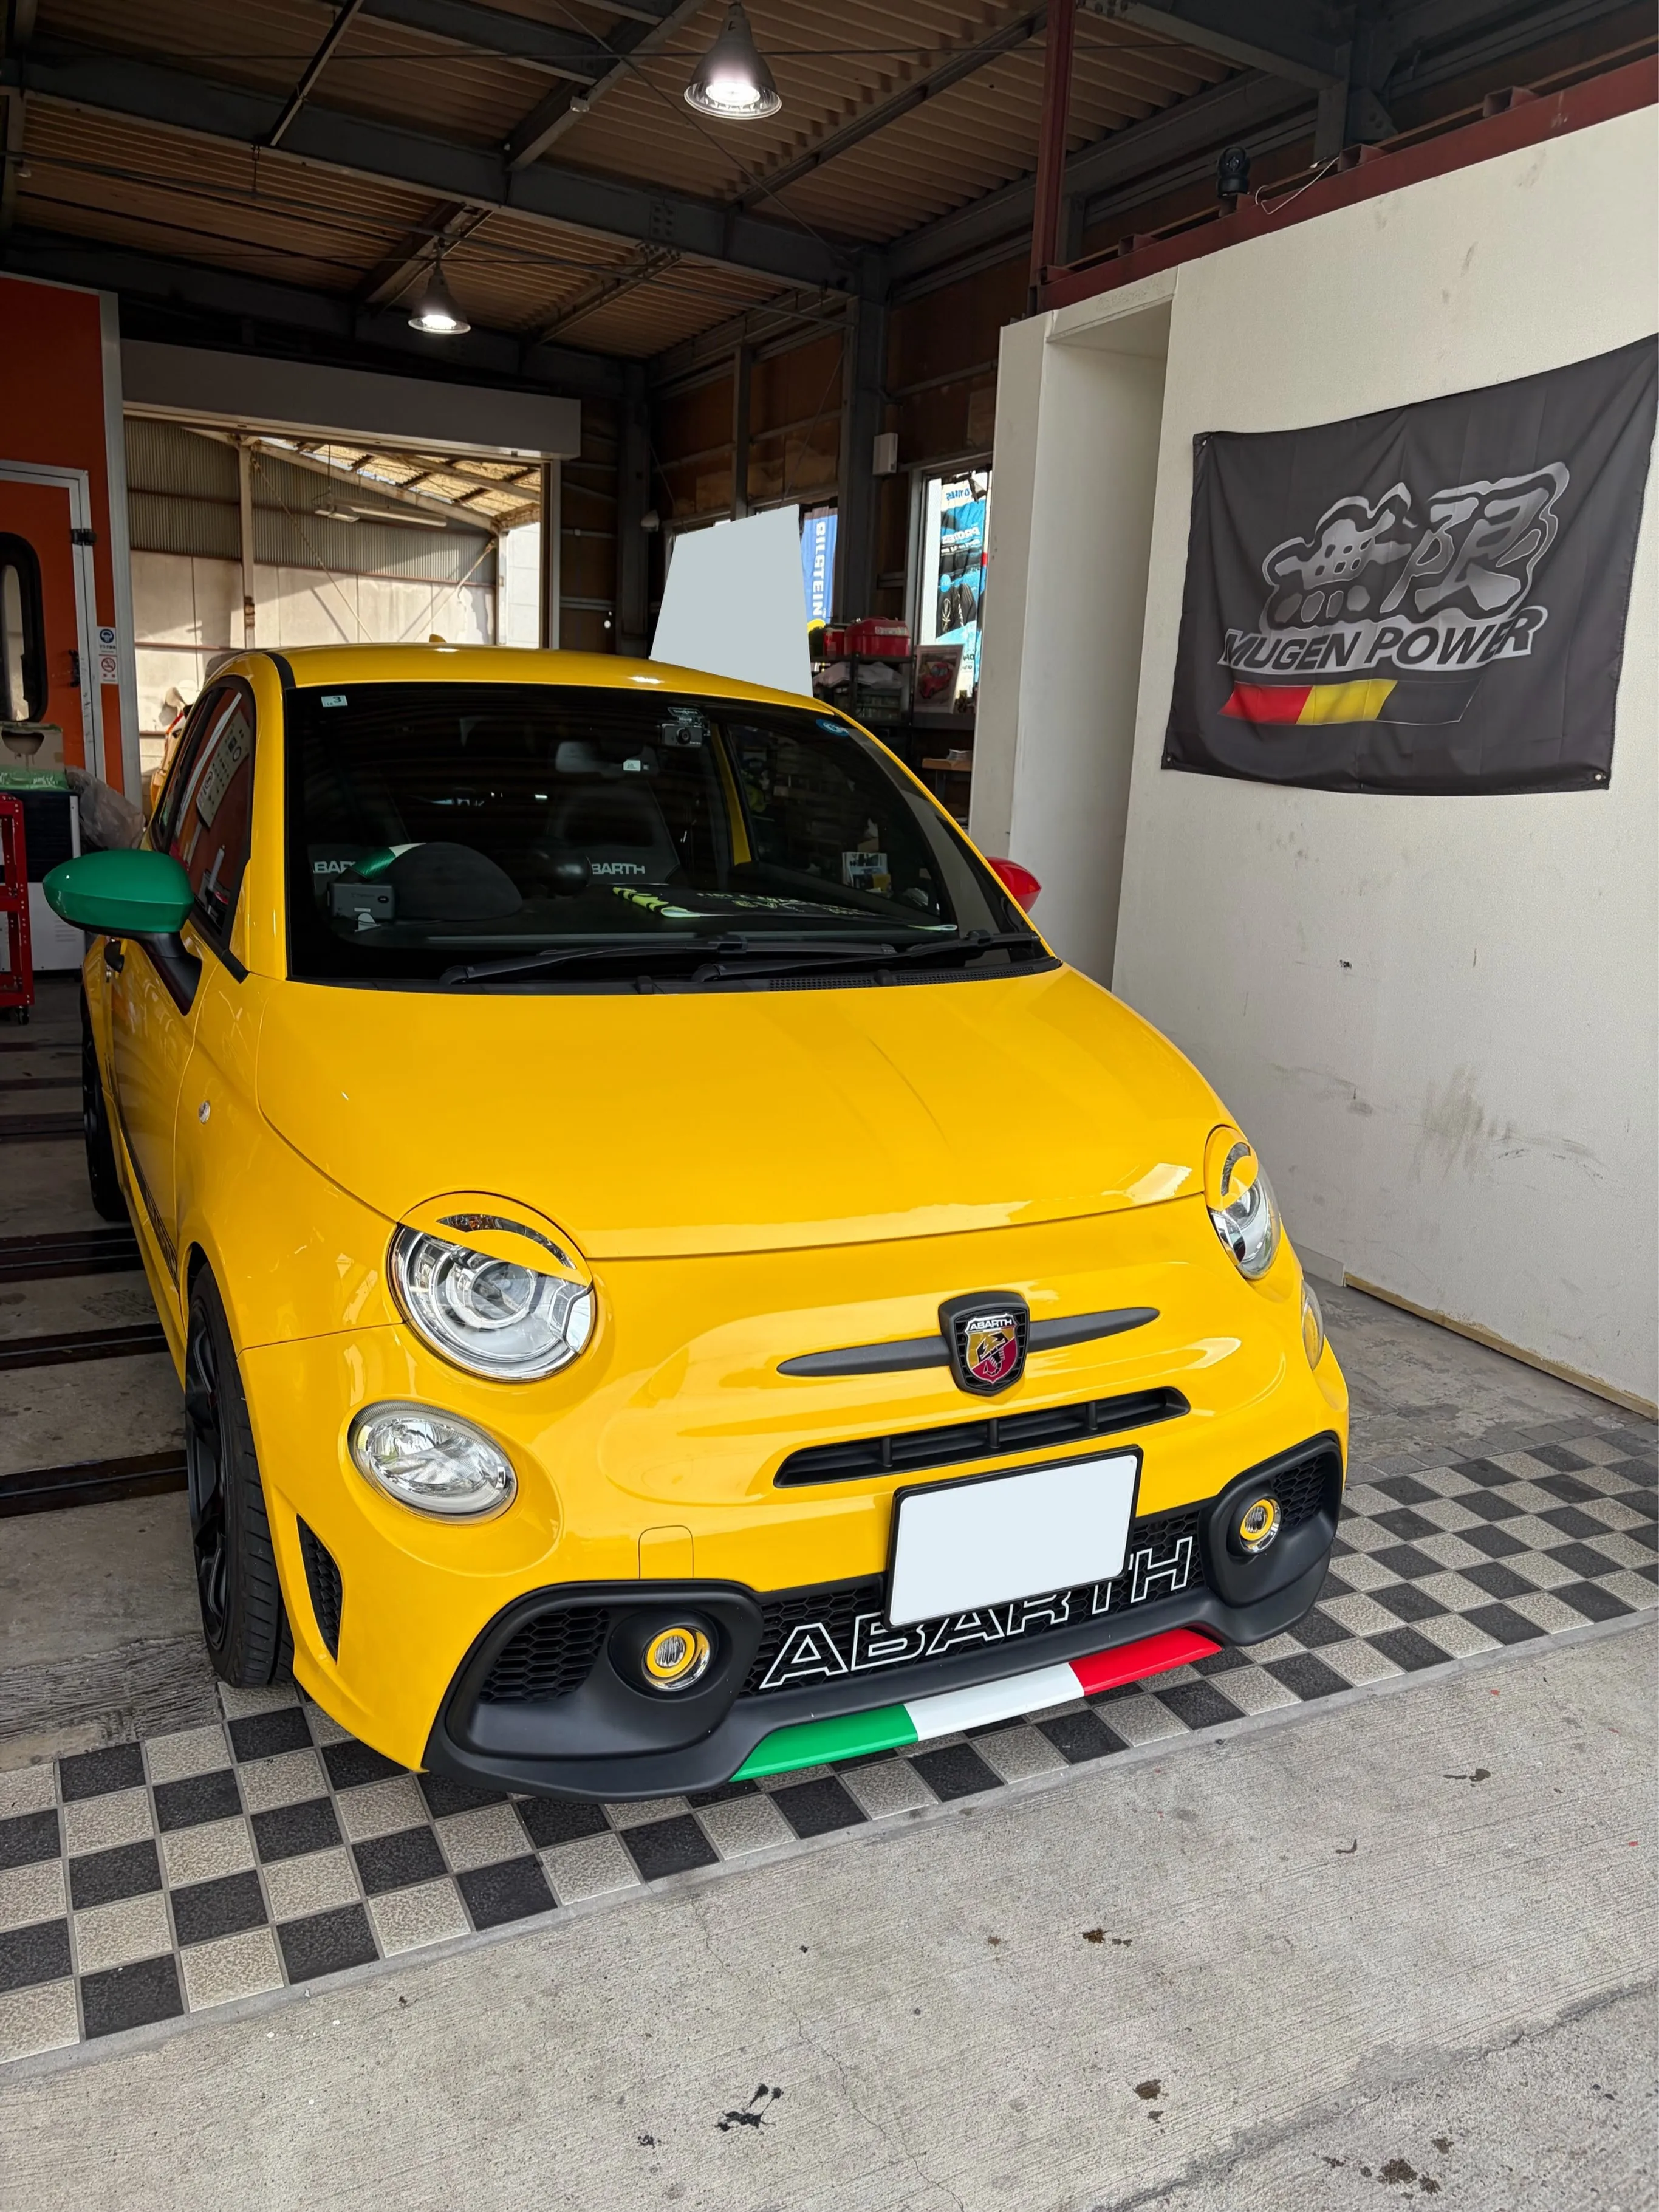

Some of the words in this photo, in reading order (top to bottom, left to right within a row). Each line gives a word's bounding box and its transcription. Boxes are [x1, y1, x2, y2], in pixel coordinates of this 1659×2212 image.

[1223, 630, 1361, 670] MUGEN
[1364, 609, 1539, 666] POWER
[313, 860, 356, 874] BAR
[592, 863, 645, 874] BARTH
[970, 1318, 1013, 1330] ABARTH
